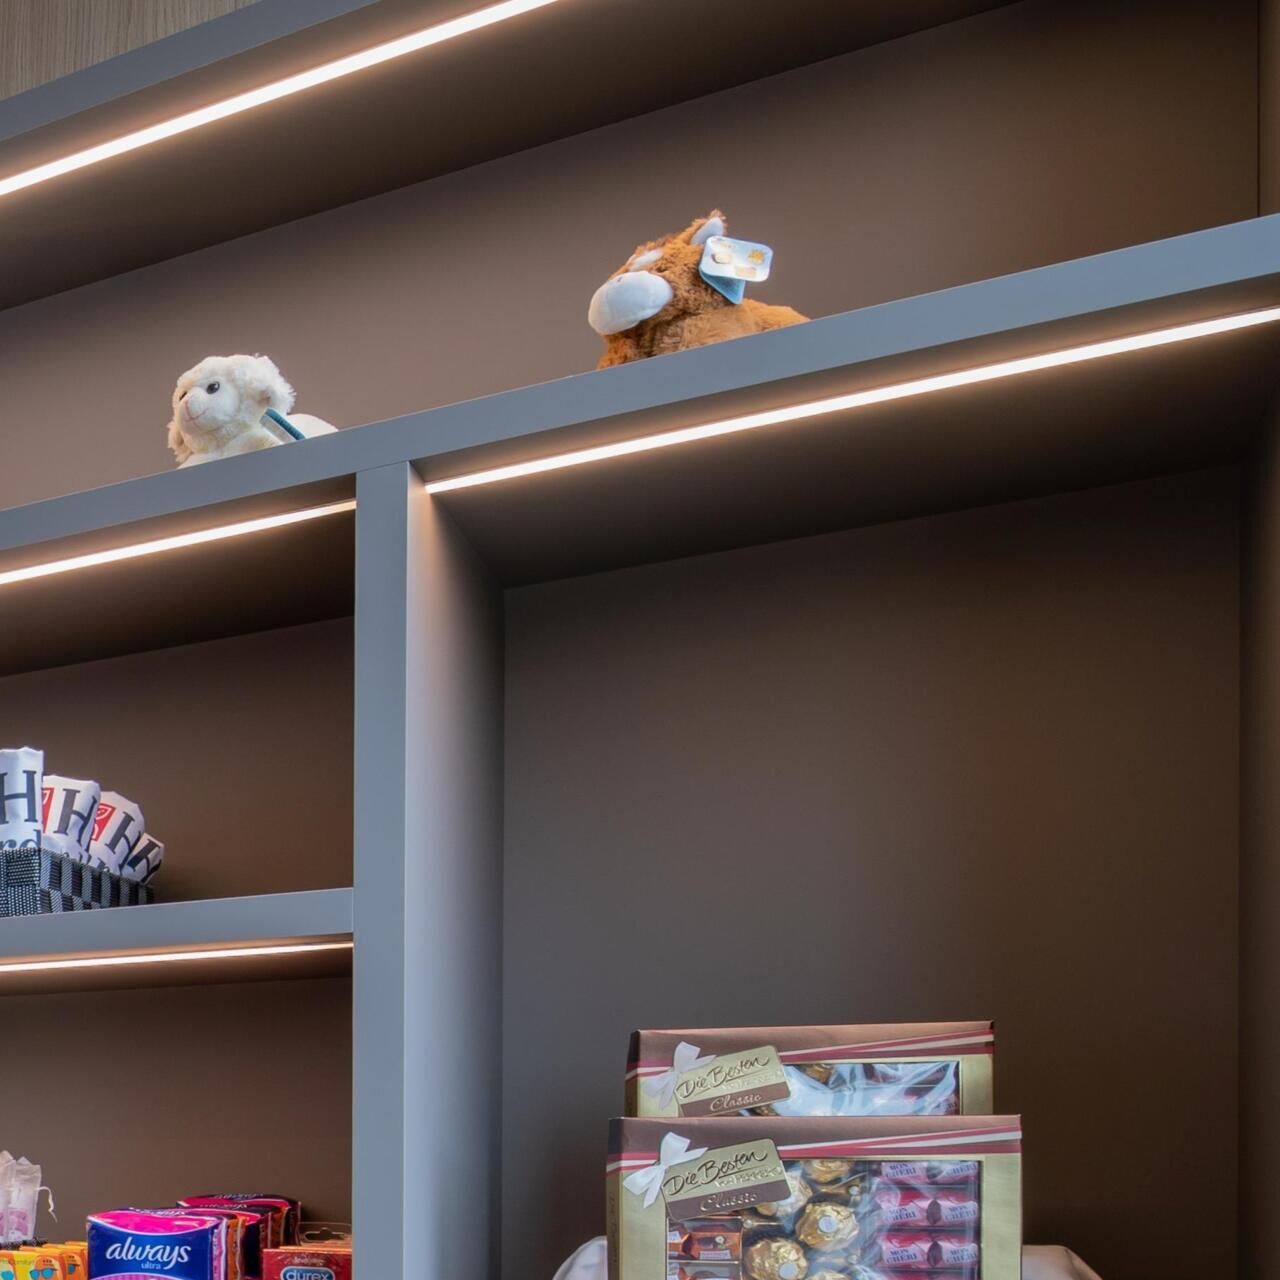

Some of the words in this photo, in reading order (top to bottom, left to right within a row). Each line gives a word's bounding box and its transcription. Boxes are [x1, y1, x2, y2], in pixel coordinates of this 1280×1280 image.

[675, 1072, 708, 1099] Die
[710, 1055, 770, 1084] Besten
[710, 1093, 763, 1112] Classic
[663, 1168, 698, 1195] Die
[698, 1149, 769, 1183] Besten
[105, 1236, 192, 1270] always
[141, 1262, 162, 1270] ultra
